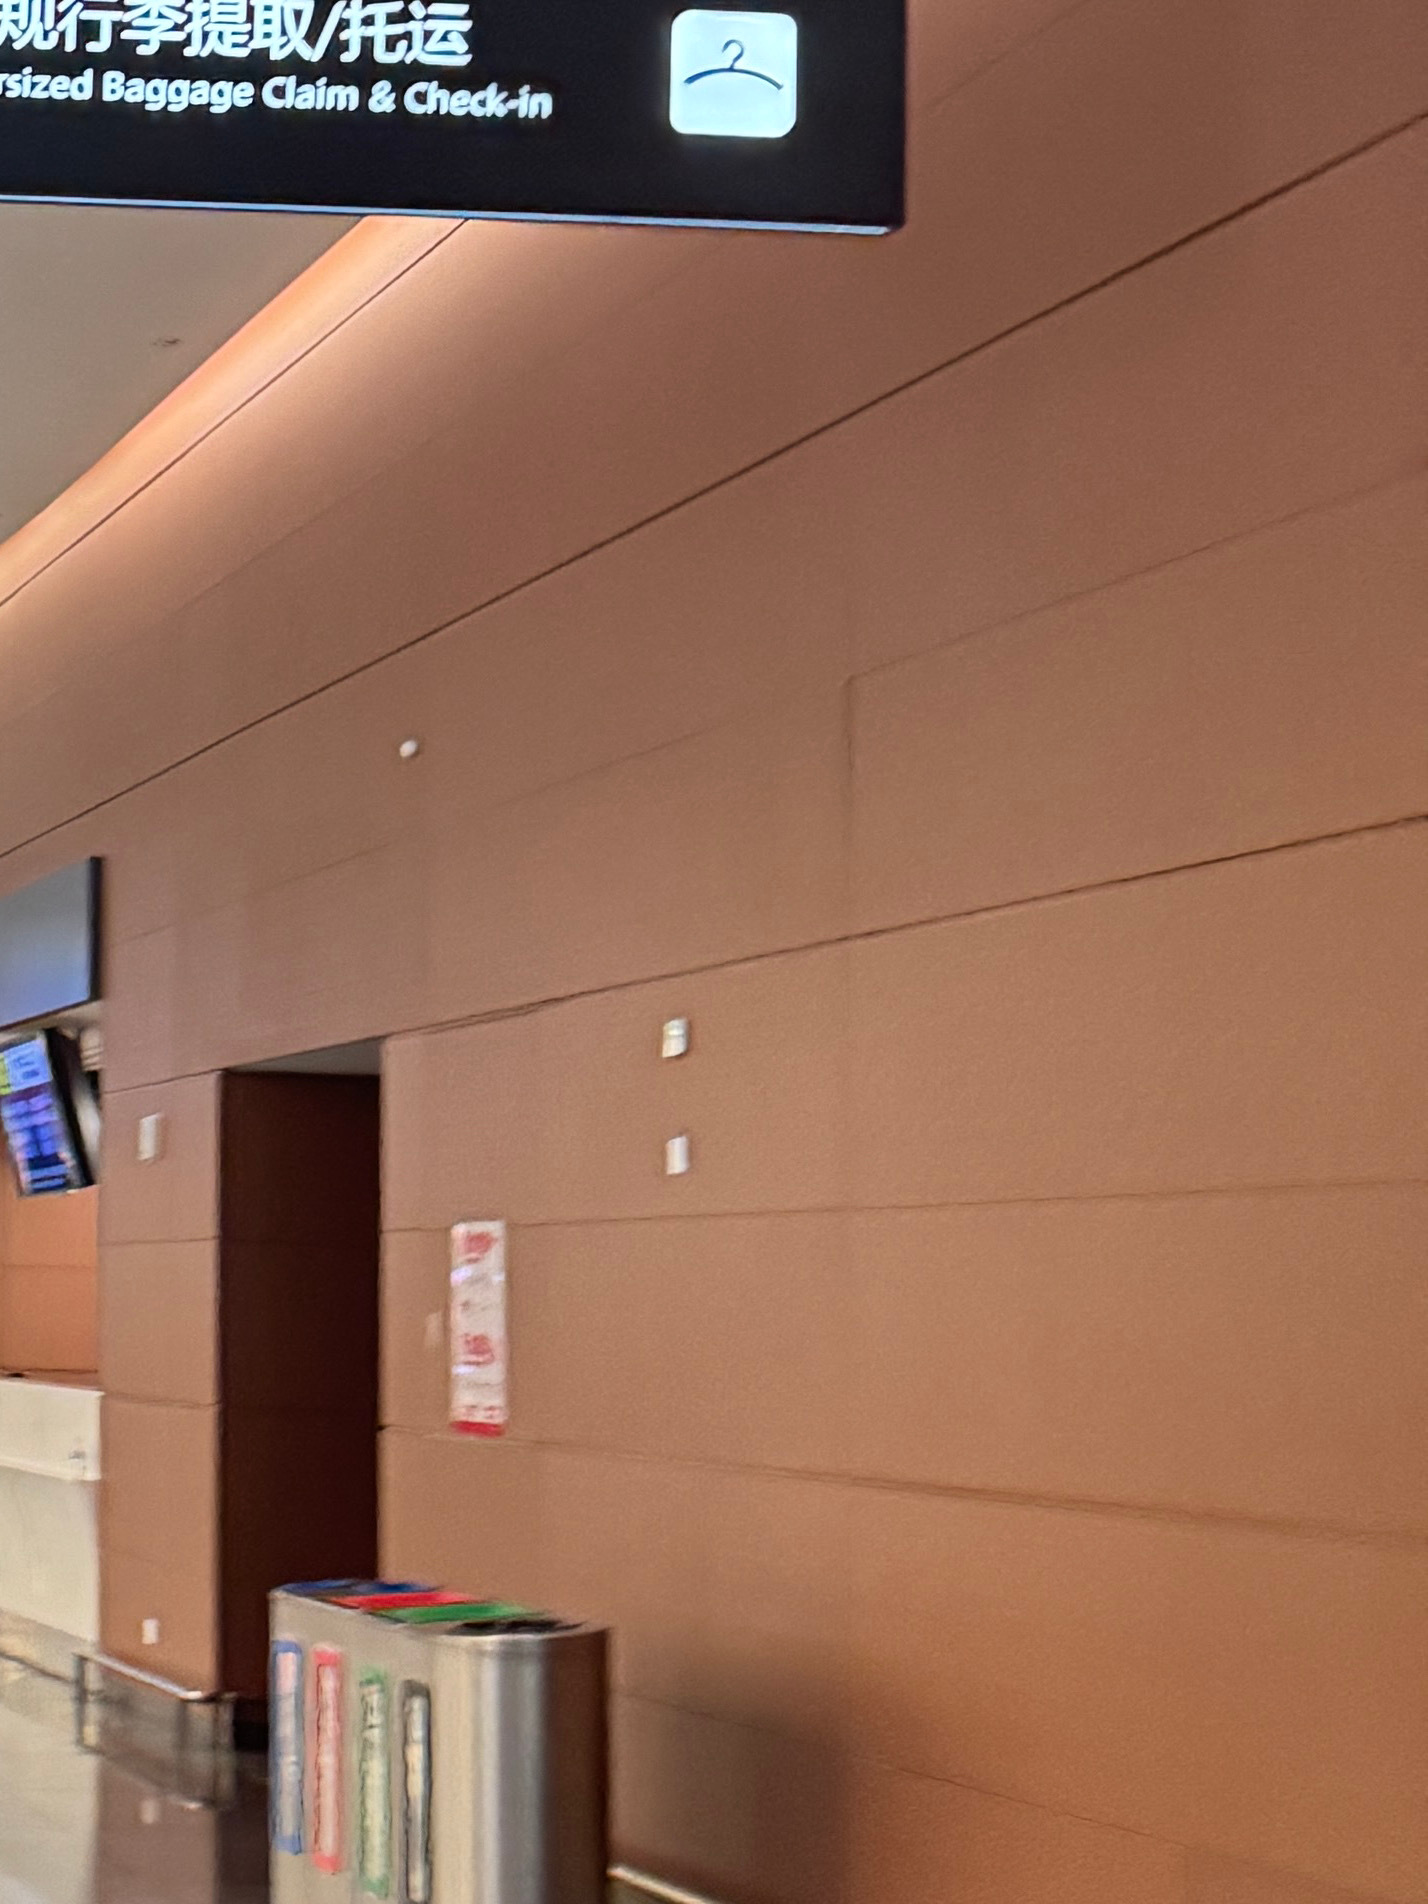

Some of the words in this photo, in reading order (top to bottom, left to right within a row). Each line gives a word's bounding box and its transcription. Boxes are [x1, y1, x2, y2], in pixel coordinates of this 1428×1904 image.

[101, 70, 254, 114] Baggage
[261, 76, 359, 113] Claim
[367, 81, 397, 114] &
[403, 80, 554, 120] Check-in
